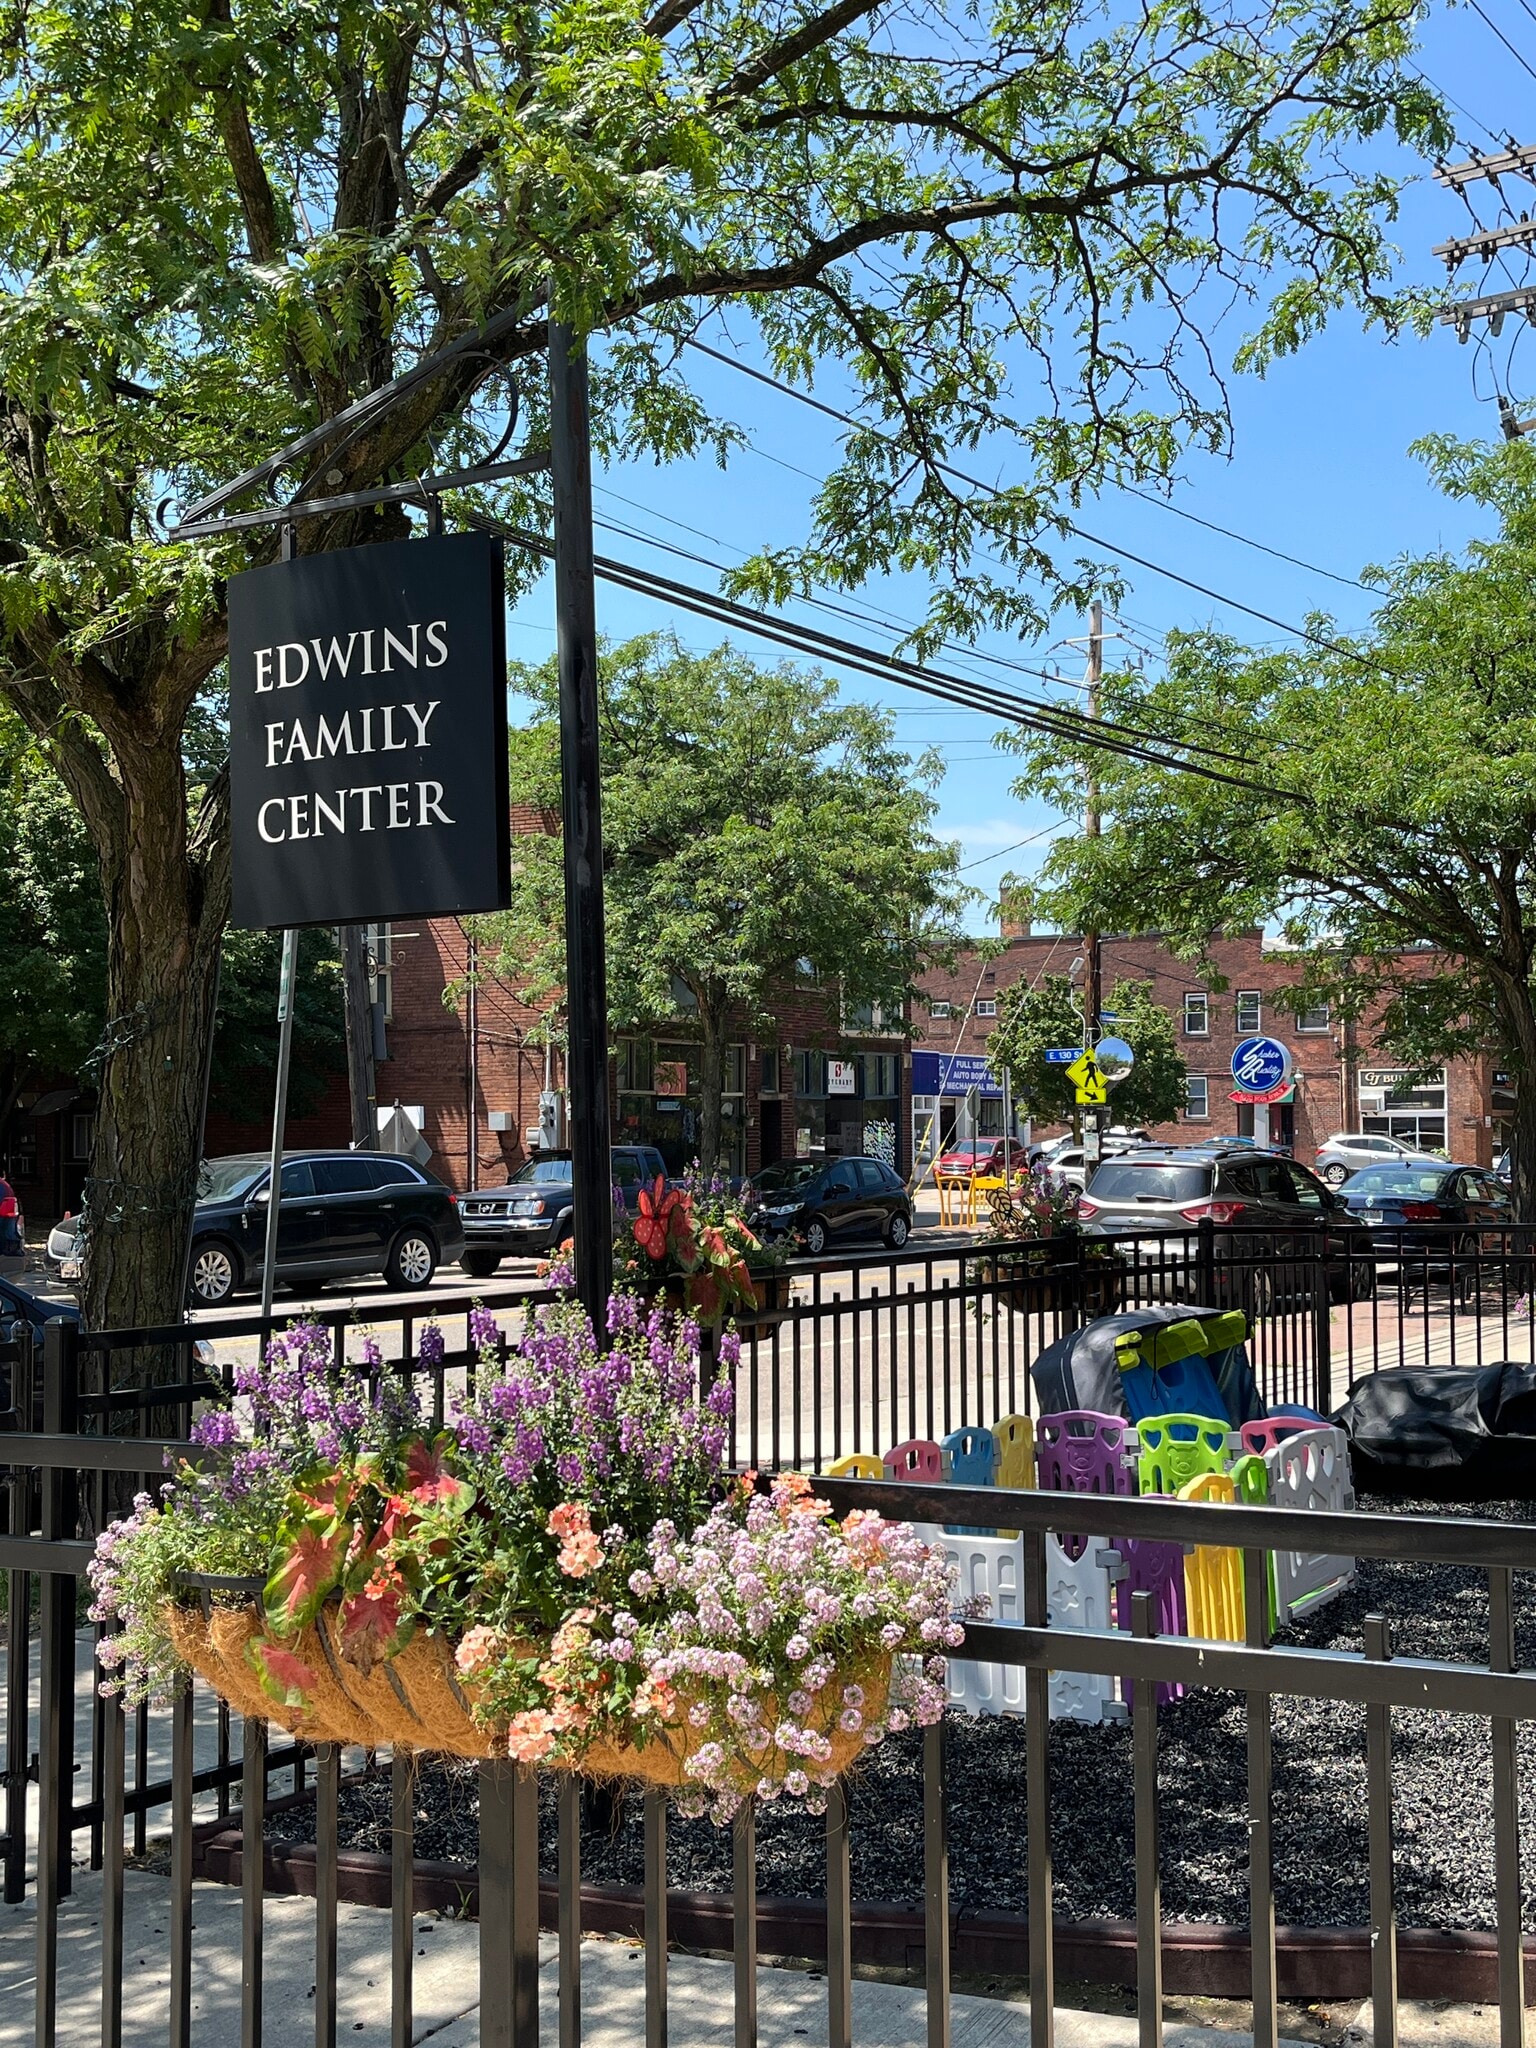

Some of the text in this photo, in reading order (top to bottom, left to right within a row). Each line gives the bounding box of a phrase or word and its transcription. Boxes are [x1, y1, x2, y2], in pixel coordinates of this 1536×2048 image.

[253, 620, 449, 693] EDWINS
[264, 700, 441, 767] FAMILY
[257, 780, 456, 843] CENTER
[956, 1061, 971, 1069] FULL
[1058, 1051, 1072, 1059] 130
[953, 1071, 970, 1079] AUTO
